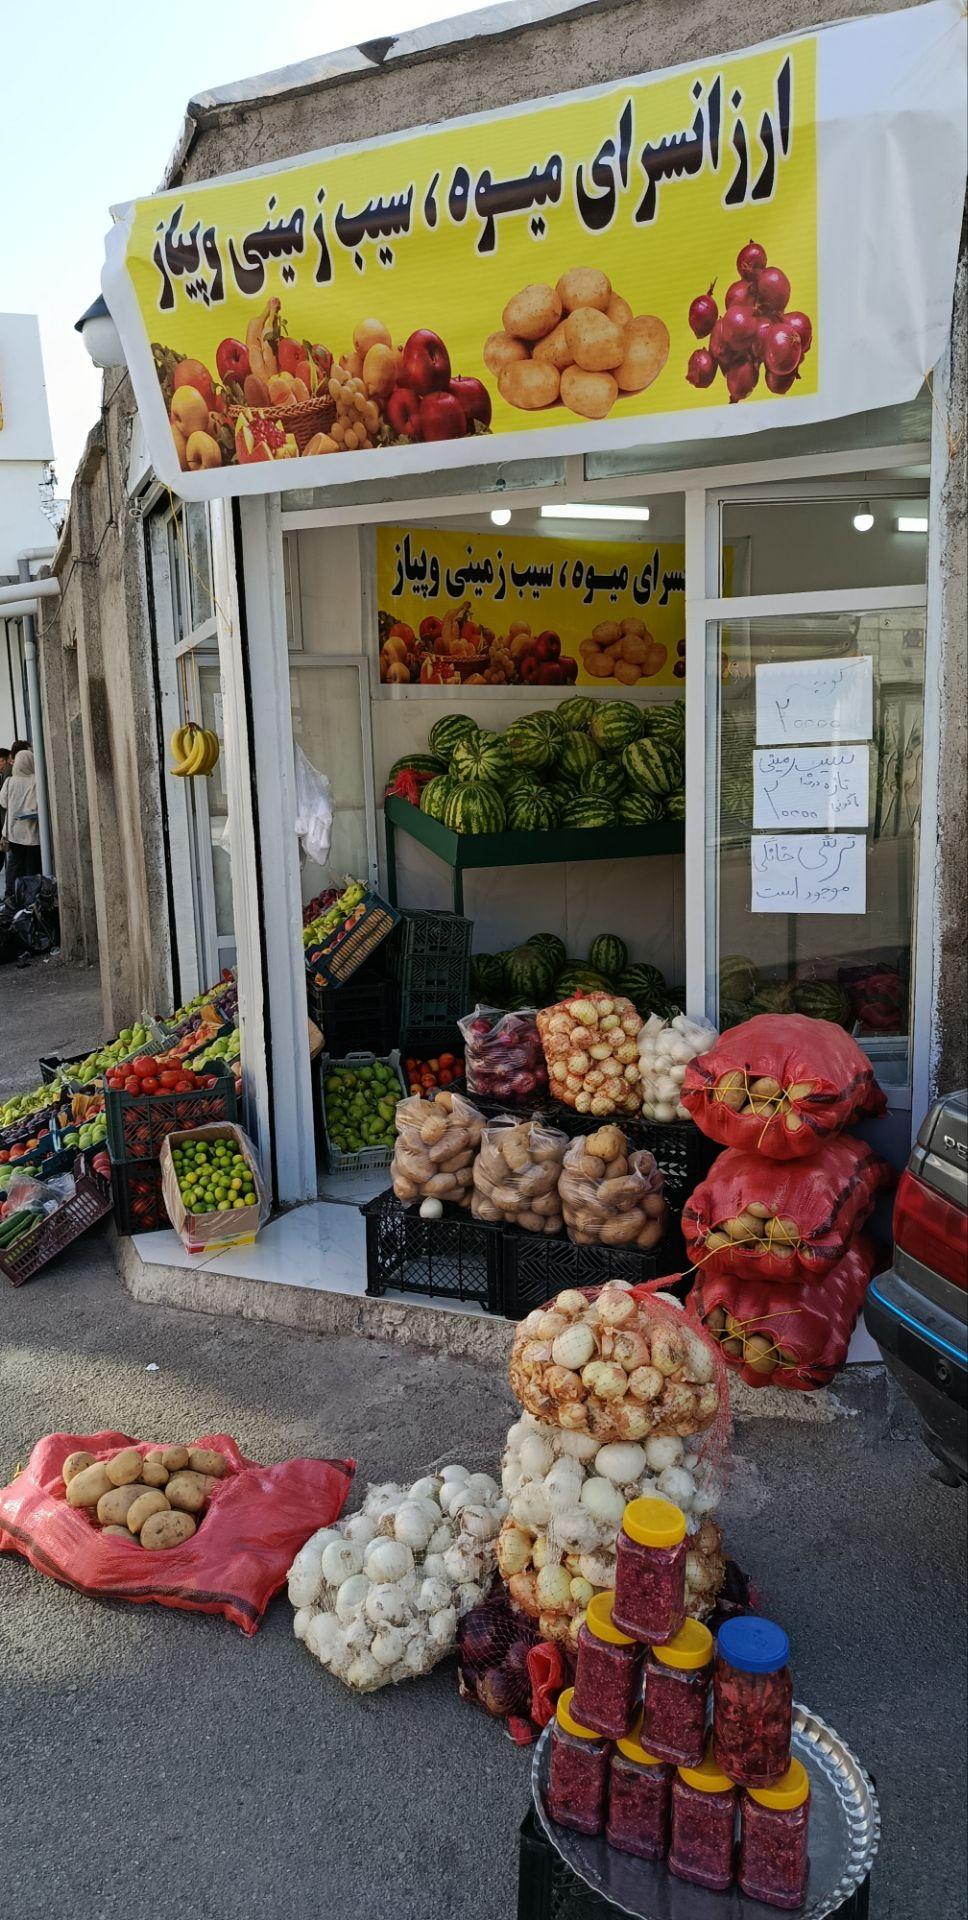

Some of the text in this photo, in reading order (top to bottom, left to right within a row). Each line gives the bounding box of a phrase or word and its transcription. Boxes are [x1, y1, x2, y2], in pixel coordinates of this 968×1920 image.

[228, 187, 333, 295] زمینی
[334, 184, 414, 272] سیب
[445, 545, 506, 600] زمینی
[511, 562, 554, 599] سیب
[756, 876, 850, 904] موجود است
